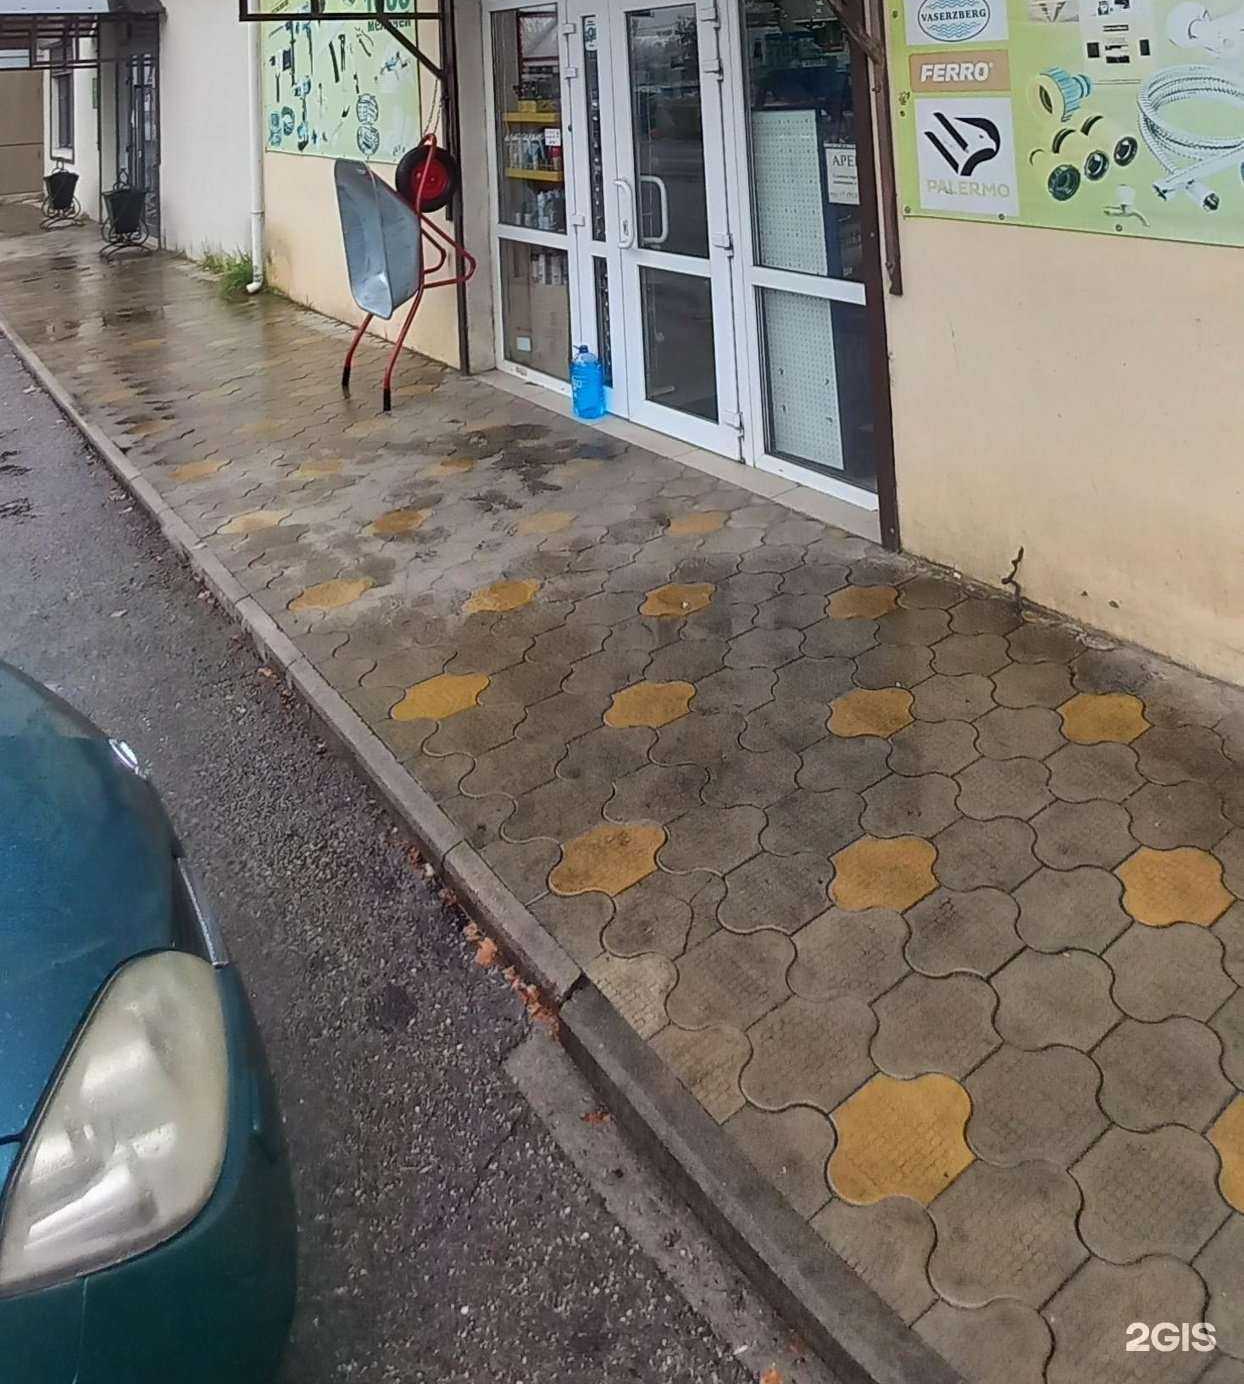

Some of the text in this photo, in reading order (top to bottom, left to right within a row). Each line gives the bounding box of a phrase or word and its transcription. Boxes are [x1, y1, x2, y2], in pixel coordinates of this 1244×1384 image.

[920, 8, 987, 23] VASERZBERG
[920, 61, 989, 83] FERRO
[927, 179, 1010, 197] PALERMO
